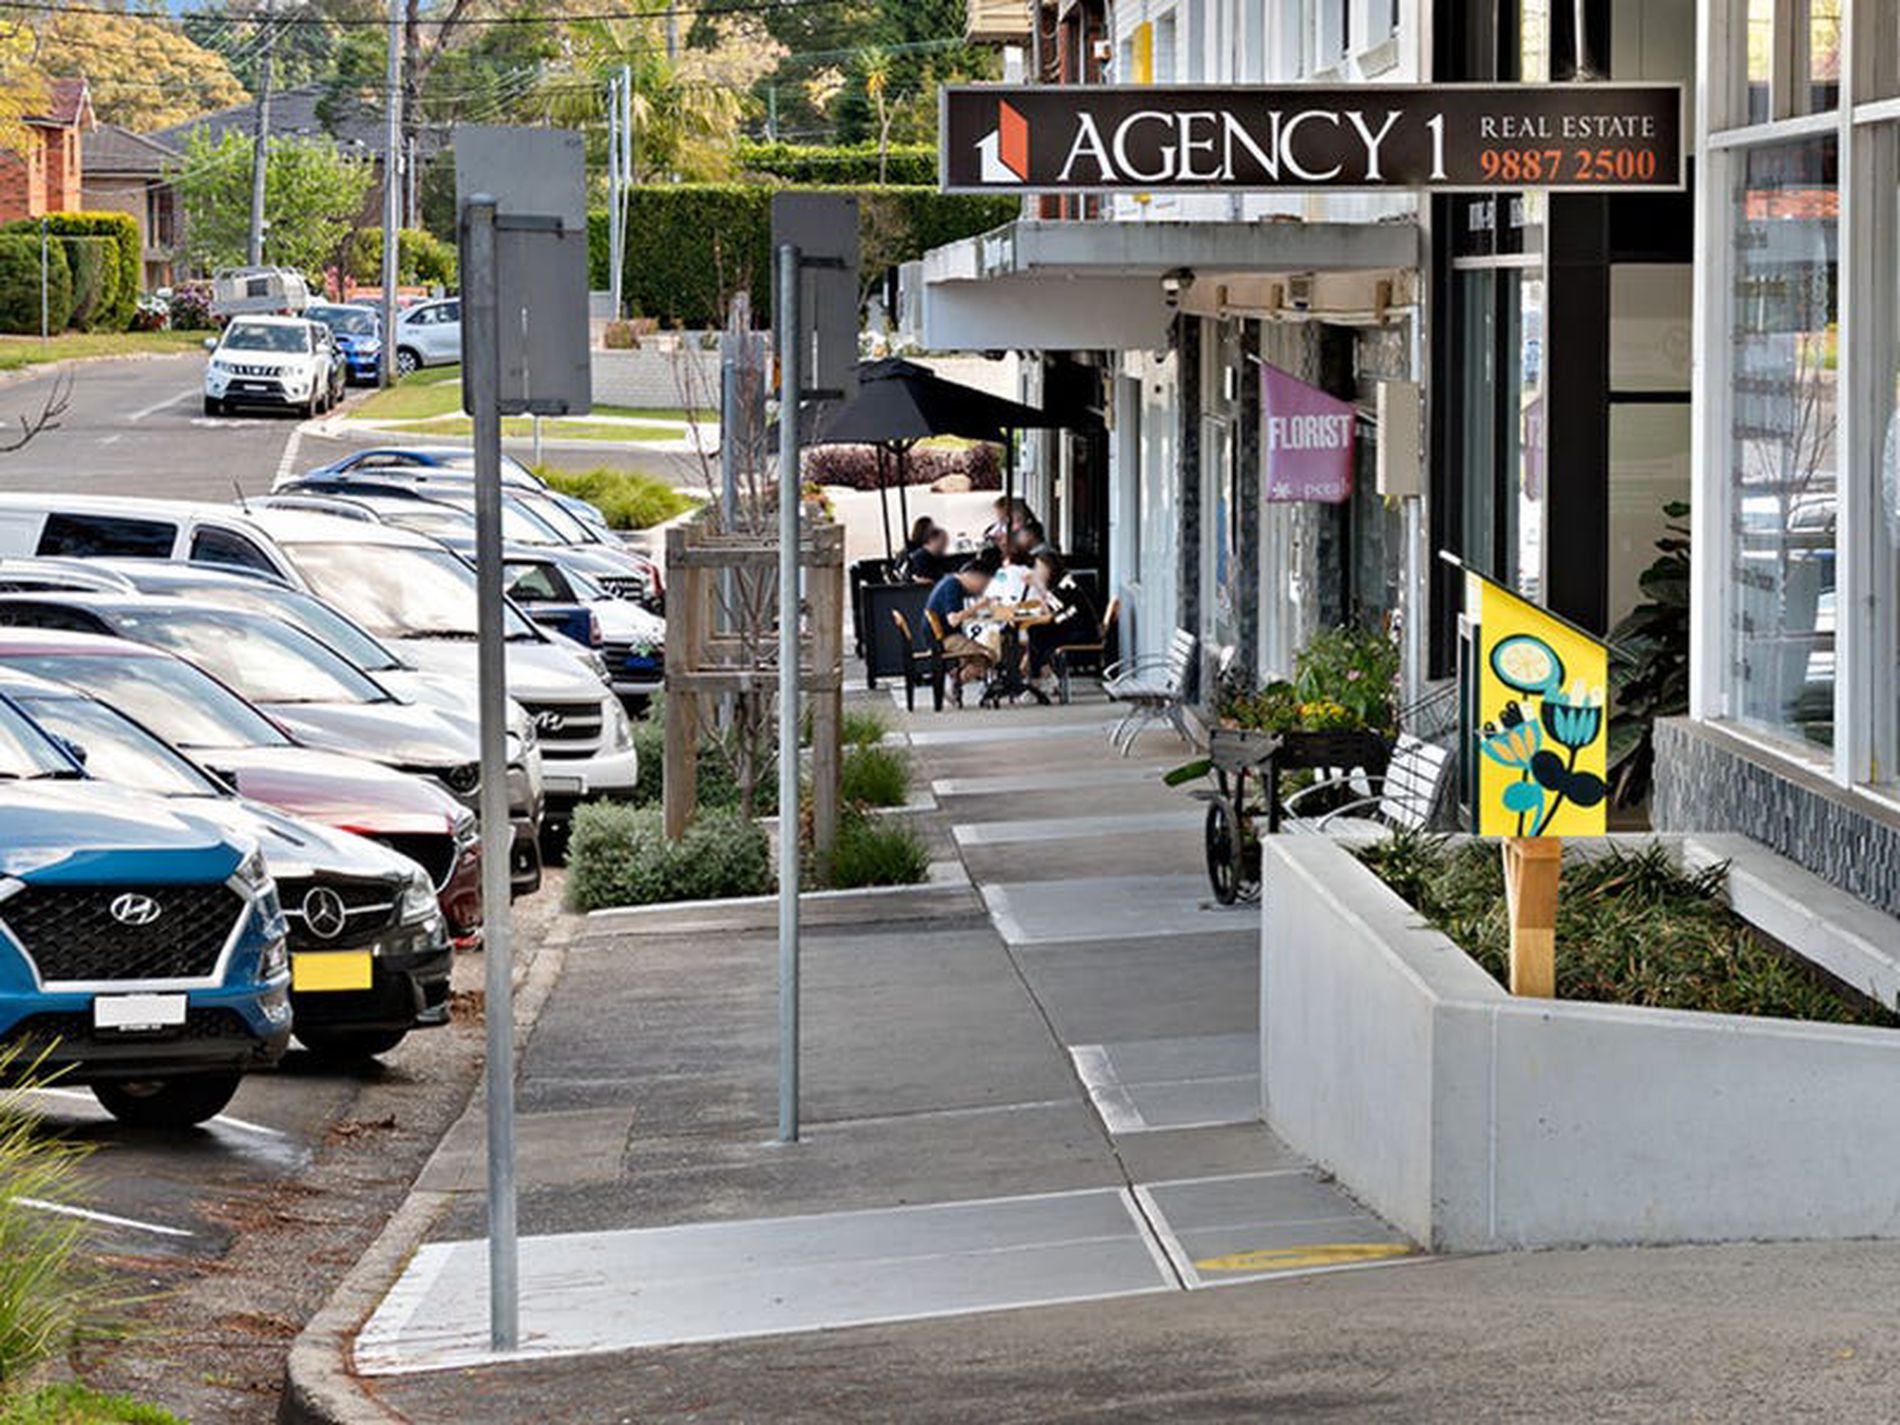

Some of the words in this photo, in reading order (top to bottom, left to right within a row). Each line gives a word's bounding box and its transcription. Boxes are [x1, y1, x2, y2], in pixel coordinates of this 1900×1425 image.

[1481, 116, 1552, 138] REAL
[1563, 115, 1655, 138] ESTATE
[1057, 110, 1403, 182] AGENCY
[1425, 113, 1449, 181] 1
[1481, 148, 1562, 180] 9887
[1575, 148, 1656, 181] 2500
[1268, 415, 1350, 450] FLORIST
